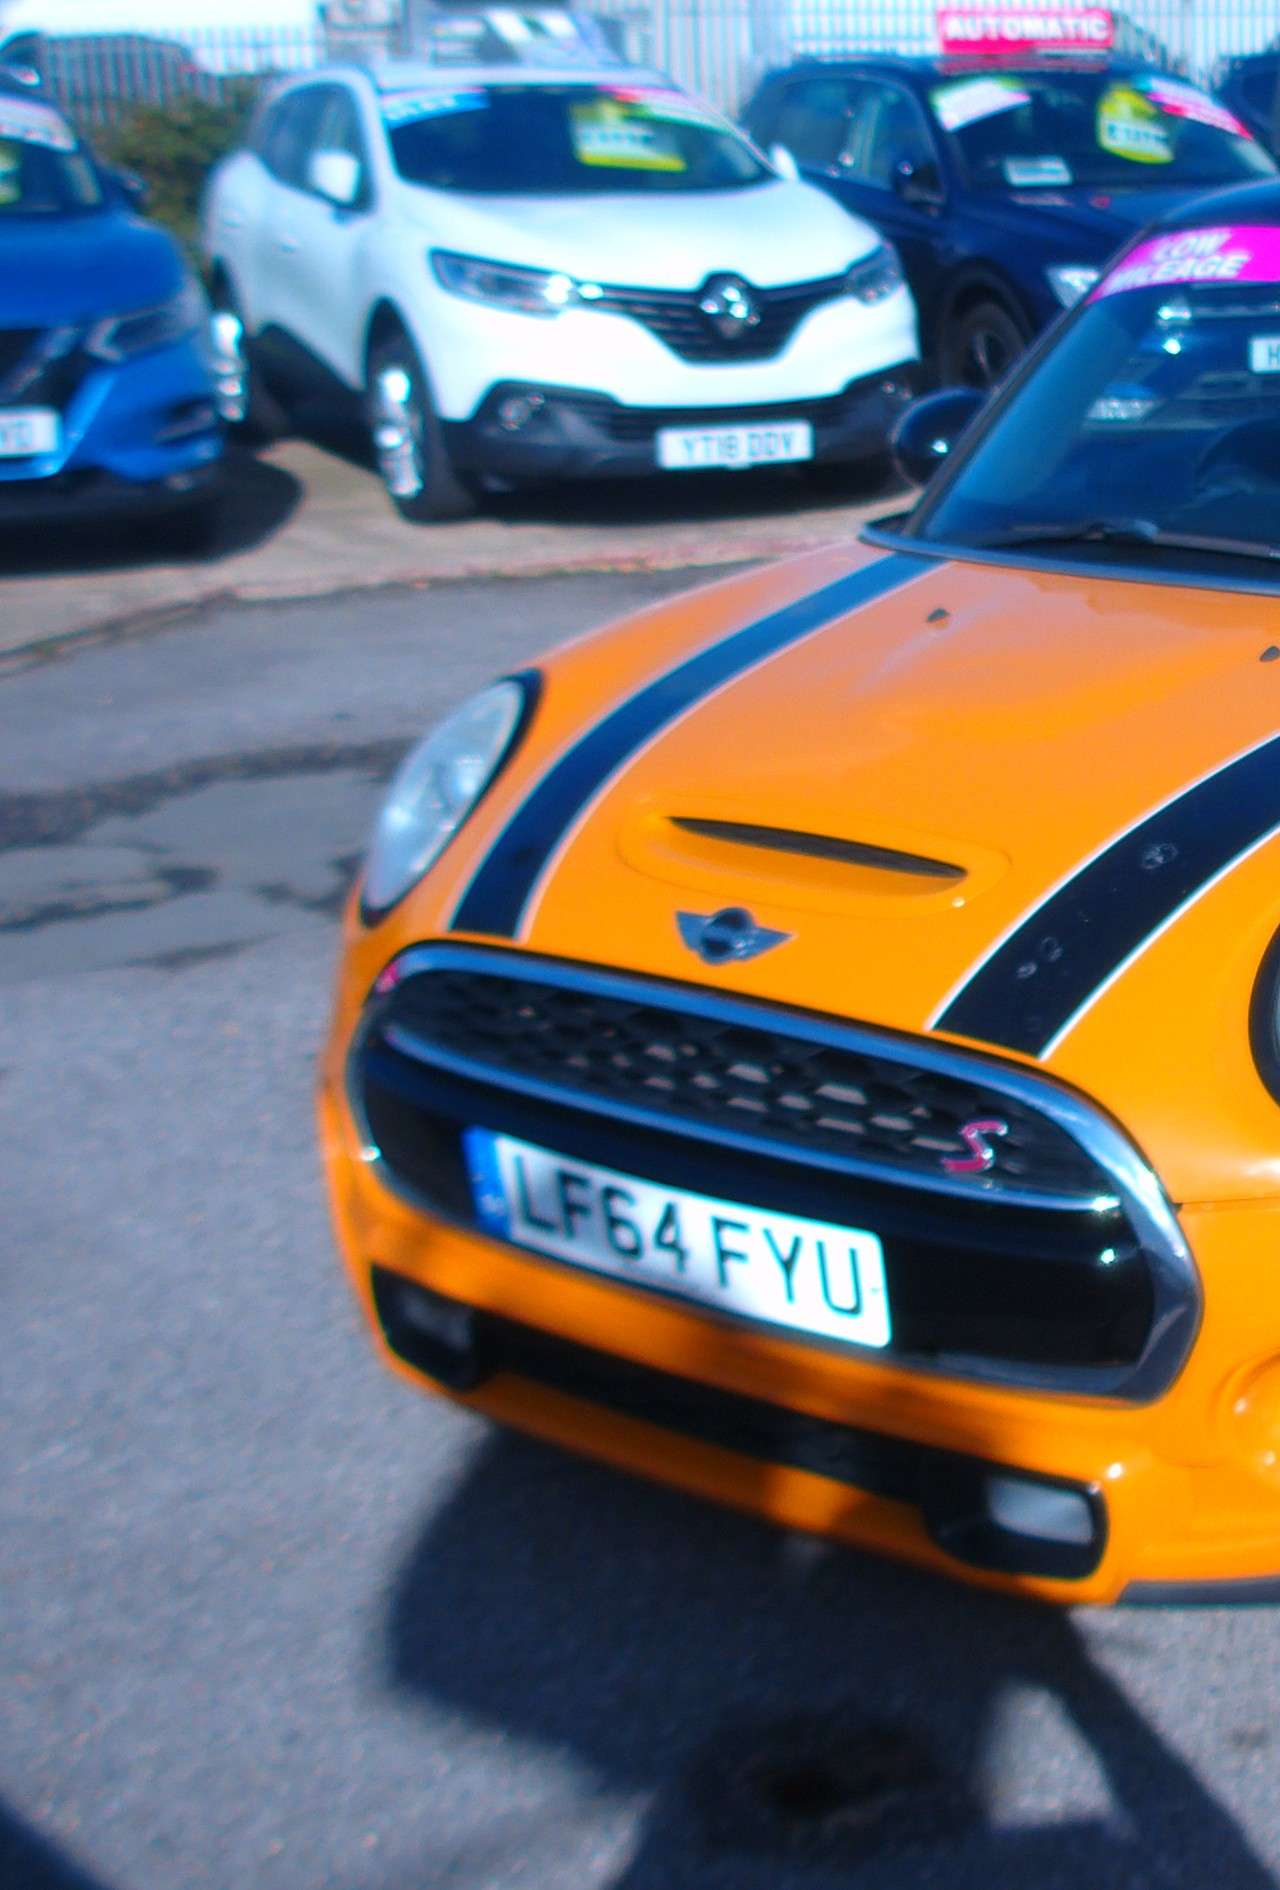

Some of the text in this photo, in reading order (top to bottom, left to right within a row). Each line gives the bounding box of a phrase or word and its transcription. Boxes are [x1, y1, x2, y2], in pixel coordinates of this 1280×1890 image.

[944, 15, 1108, 42] AUTOMATIC
[1153, 230, 1233, 262] LOW
[941, 1118, 1008, 1173] S
[512, 1154, 864, 1319] LF64 FYU
